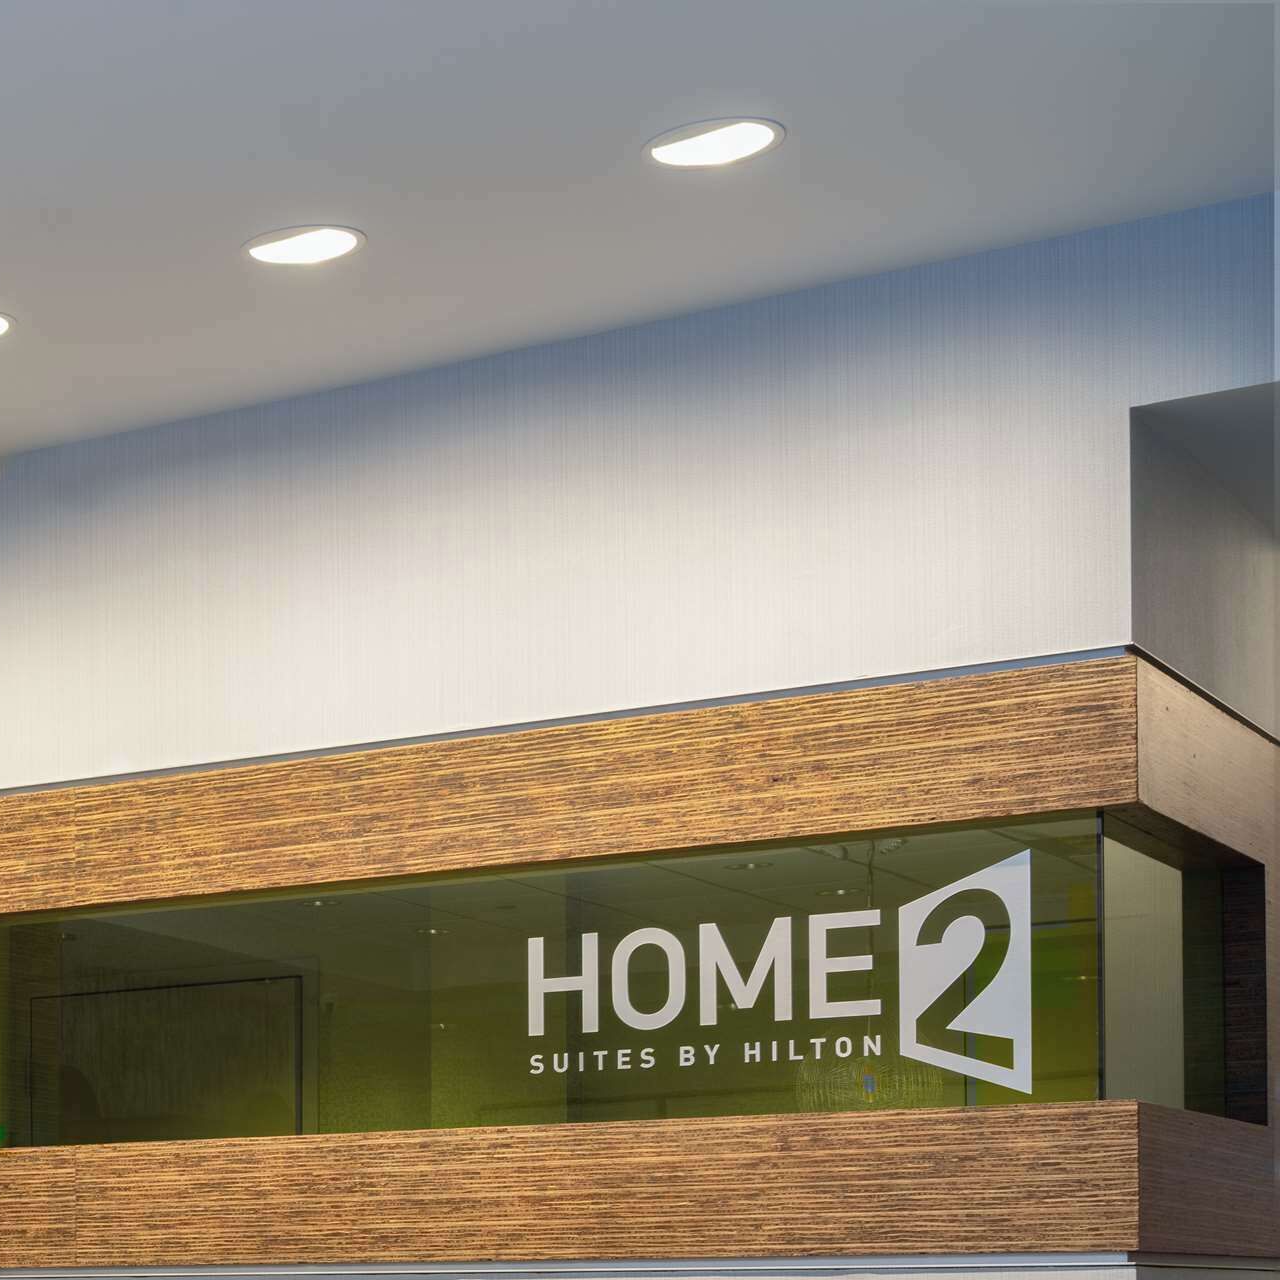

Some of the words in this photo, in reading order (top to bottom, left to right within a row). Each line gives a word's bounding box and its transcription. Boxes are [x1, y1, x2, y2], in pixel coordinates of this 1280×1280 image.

[529, 1047, 657, 1075] SUITES
[679, 1043, 721, 1067] BY
[744, 1035, 882, 1064] HILTON
